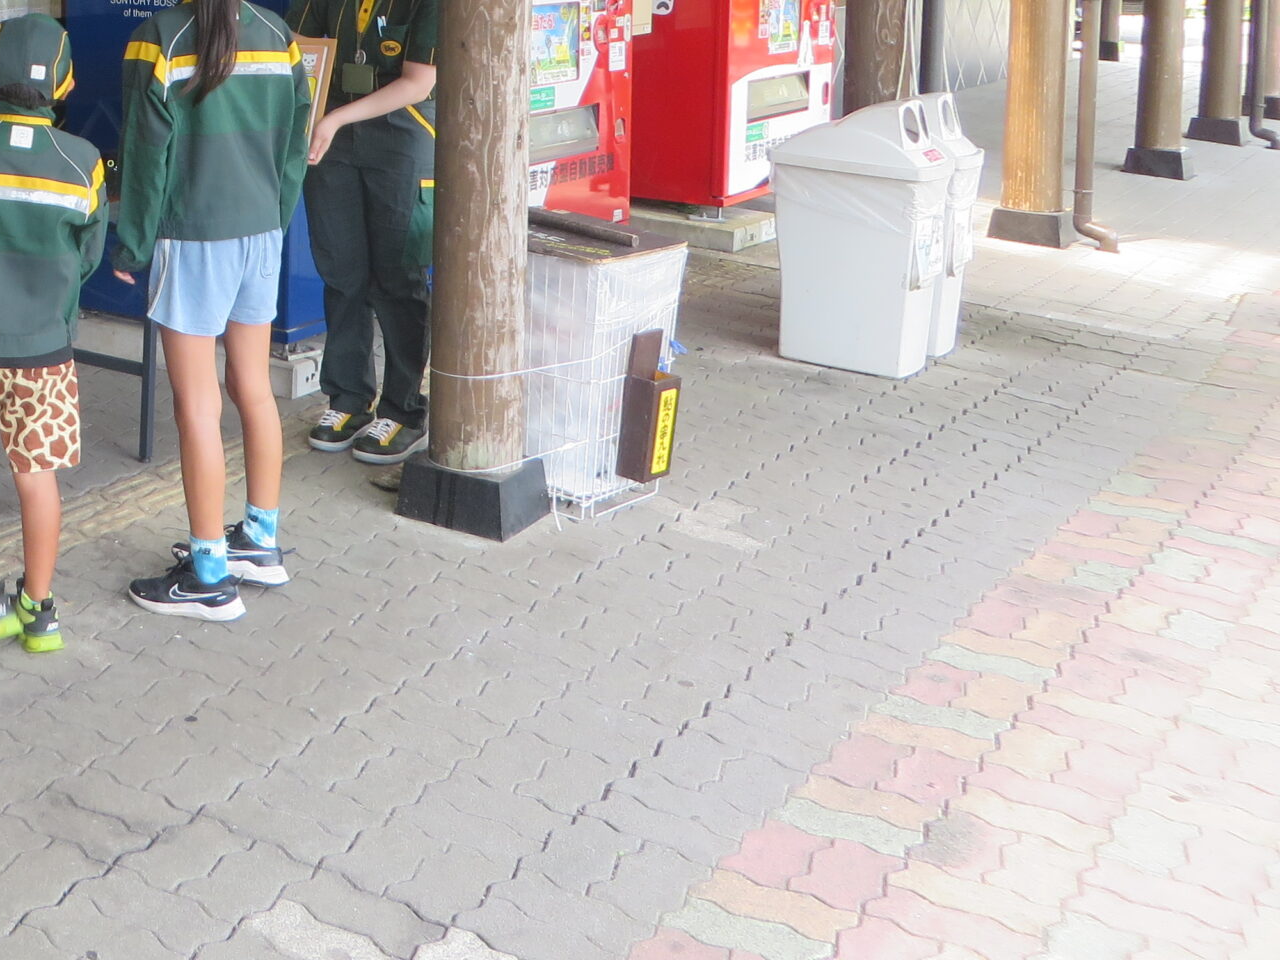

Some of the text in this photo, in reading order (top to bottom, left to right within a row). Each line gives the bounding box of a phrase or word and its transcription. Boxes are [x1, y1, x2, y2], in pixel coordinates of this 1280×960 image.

[123, 8, 152, 18] of them
[529, 152, 614, 192] 害対応型自動販売機
